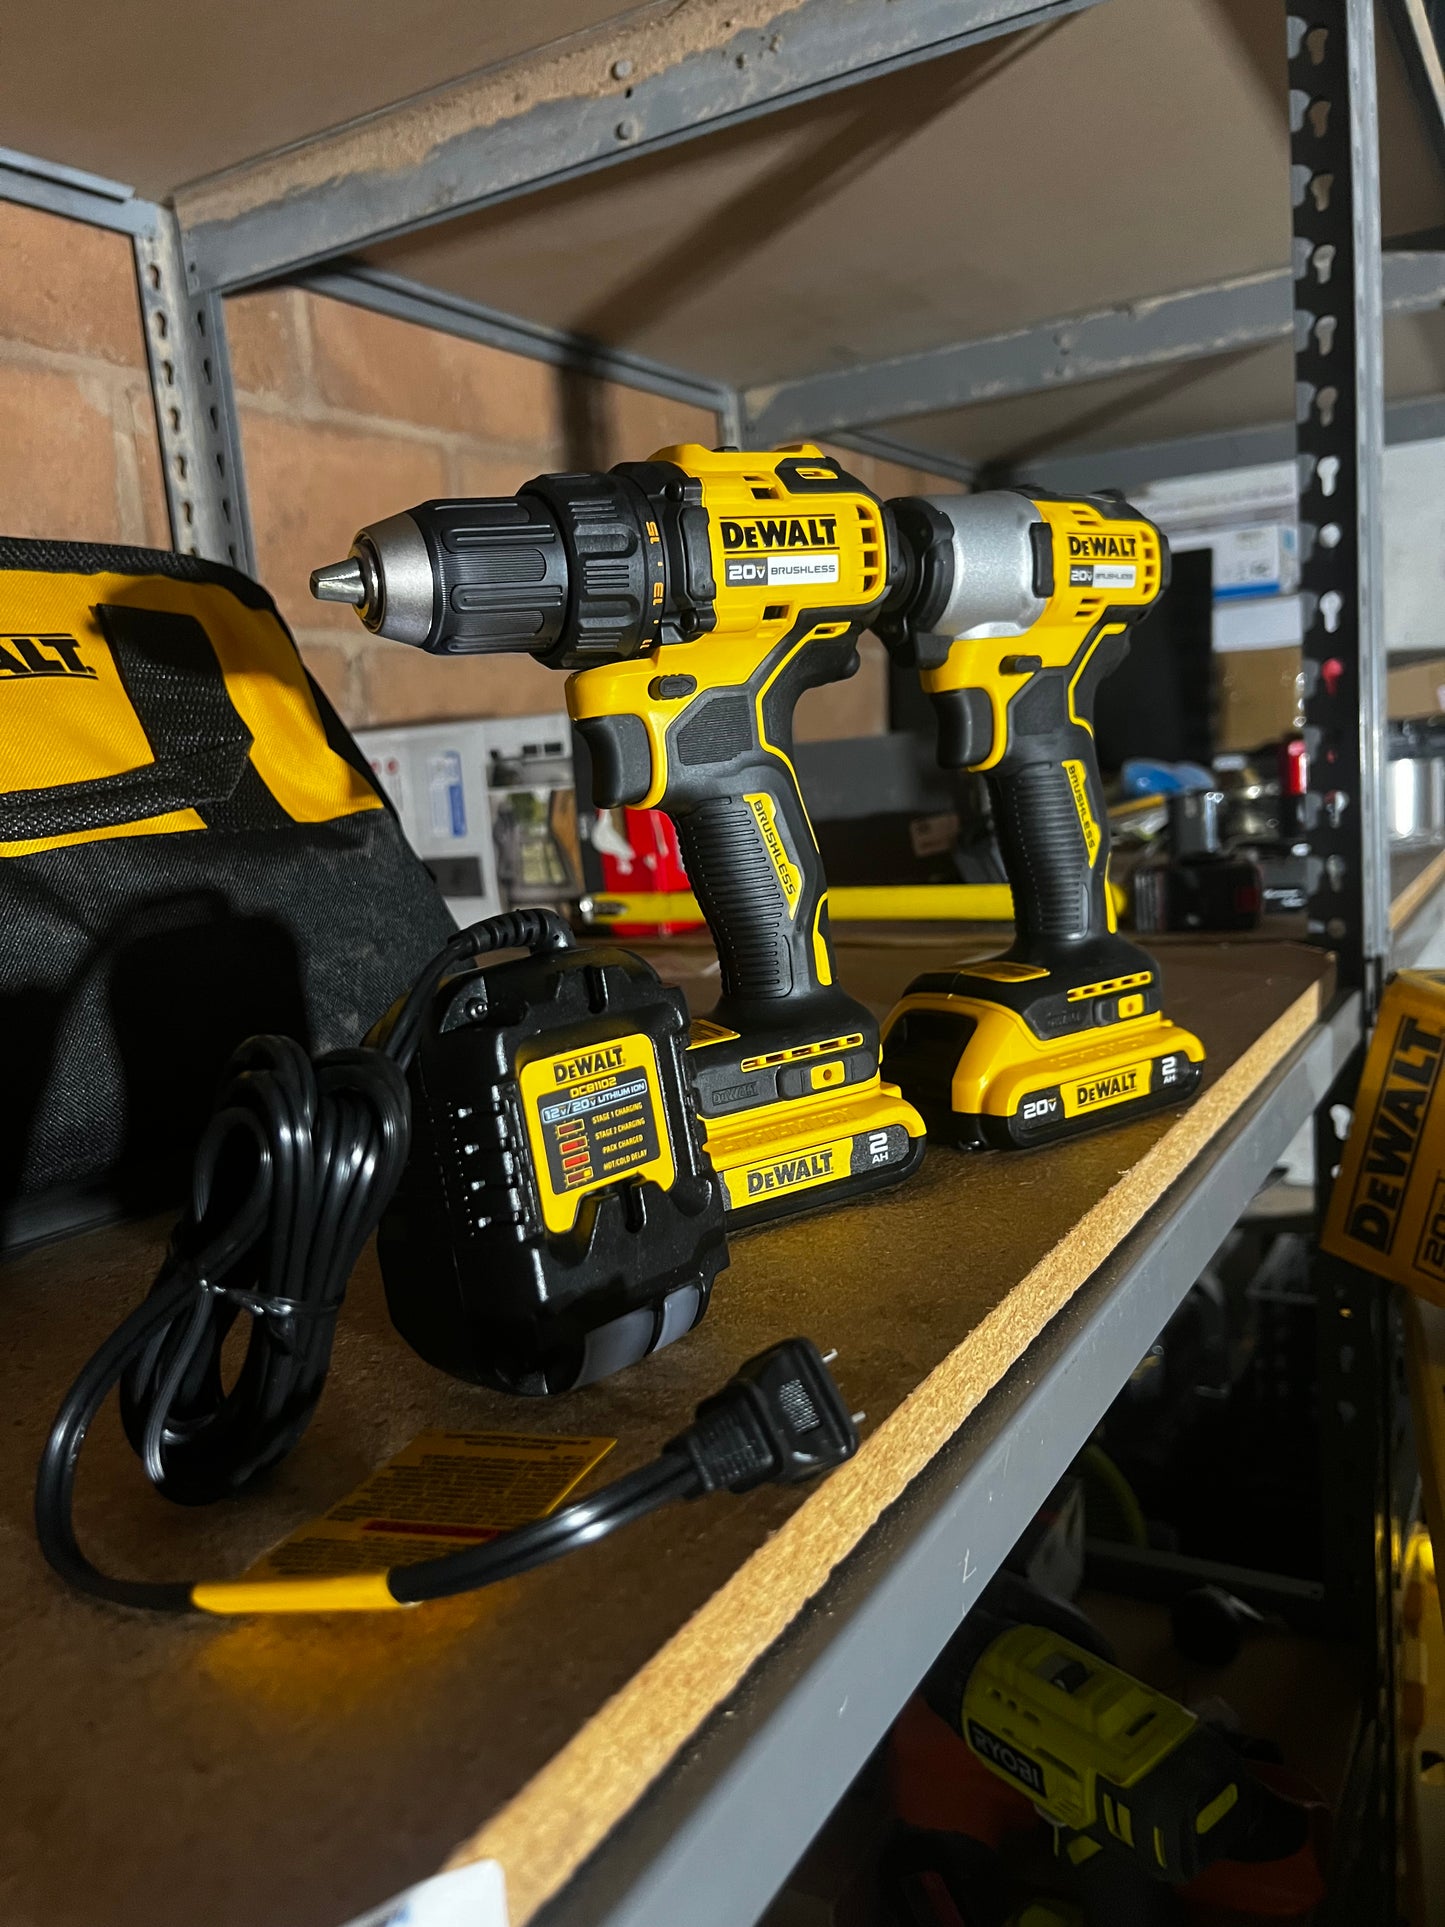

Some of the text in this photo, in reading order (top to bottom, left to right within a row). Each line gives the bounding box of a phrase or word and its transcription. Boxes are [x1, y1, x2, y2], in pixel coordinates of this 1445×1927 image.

[646, 521, 661, 544] 15
[720, 518, 837, 550] DEWALT
[1068, 535, 1136, 557] DEWALT
[728, 564, 836, 580] 20V BRUSHLESS
[652, 582, 664, 606] 13
[1068, 765, 1096, 849] BRUSHLESS
[753, 799, 797, 895] BRUSHLESS
[553, 1047, 624, 1083] DEWALT
[1161, 1056, 1177, 1075] 2
[570, 1076, 618, 1098] DCB1102
[598, 1088, 632, 1104] LITHIUM
[631, 1082, 645, 1094] ION
[1023, 1072, 1137, 1120] 20V DEWALT
[591, 1111, 611, 1124] STAGE
[615, 1101, 643, 1117] CHARGING
[595, 1128, 614, 1140] STAGE
[617, 1117, 646, 1132] CHARGING
[1349, 1017, 1443, 1255] DEWALT
[602, 1134, 644, 1154] PACK CHARGED
[868, 1131, 889, 1155] 2
[631, 1149, 648, 1162] DELAY
[871, 1153, 889, 1164] AH
[747, 1151, 833, 1194] DEWALT
[971, 1726, 1039, 1788] RYOBI
